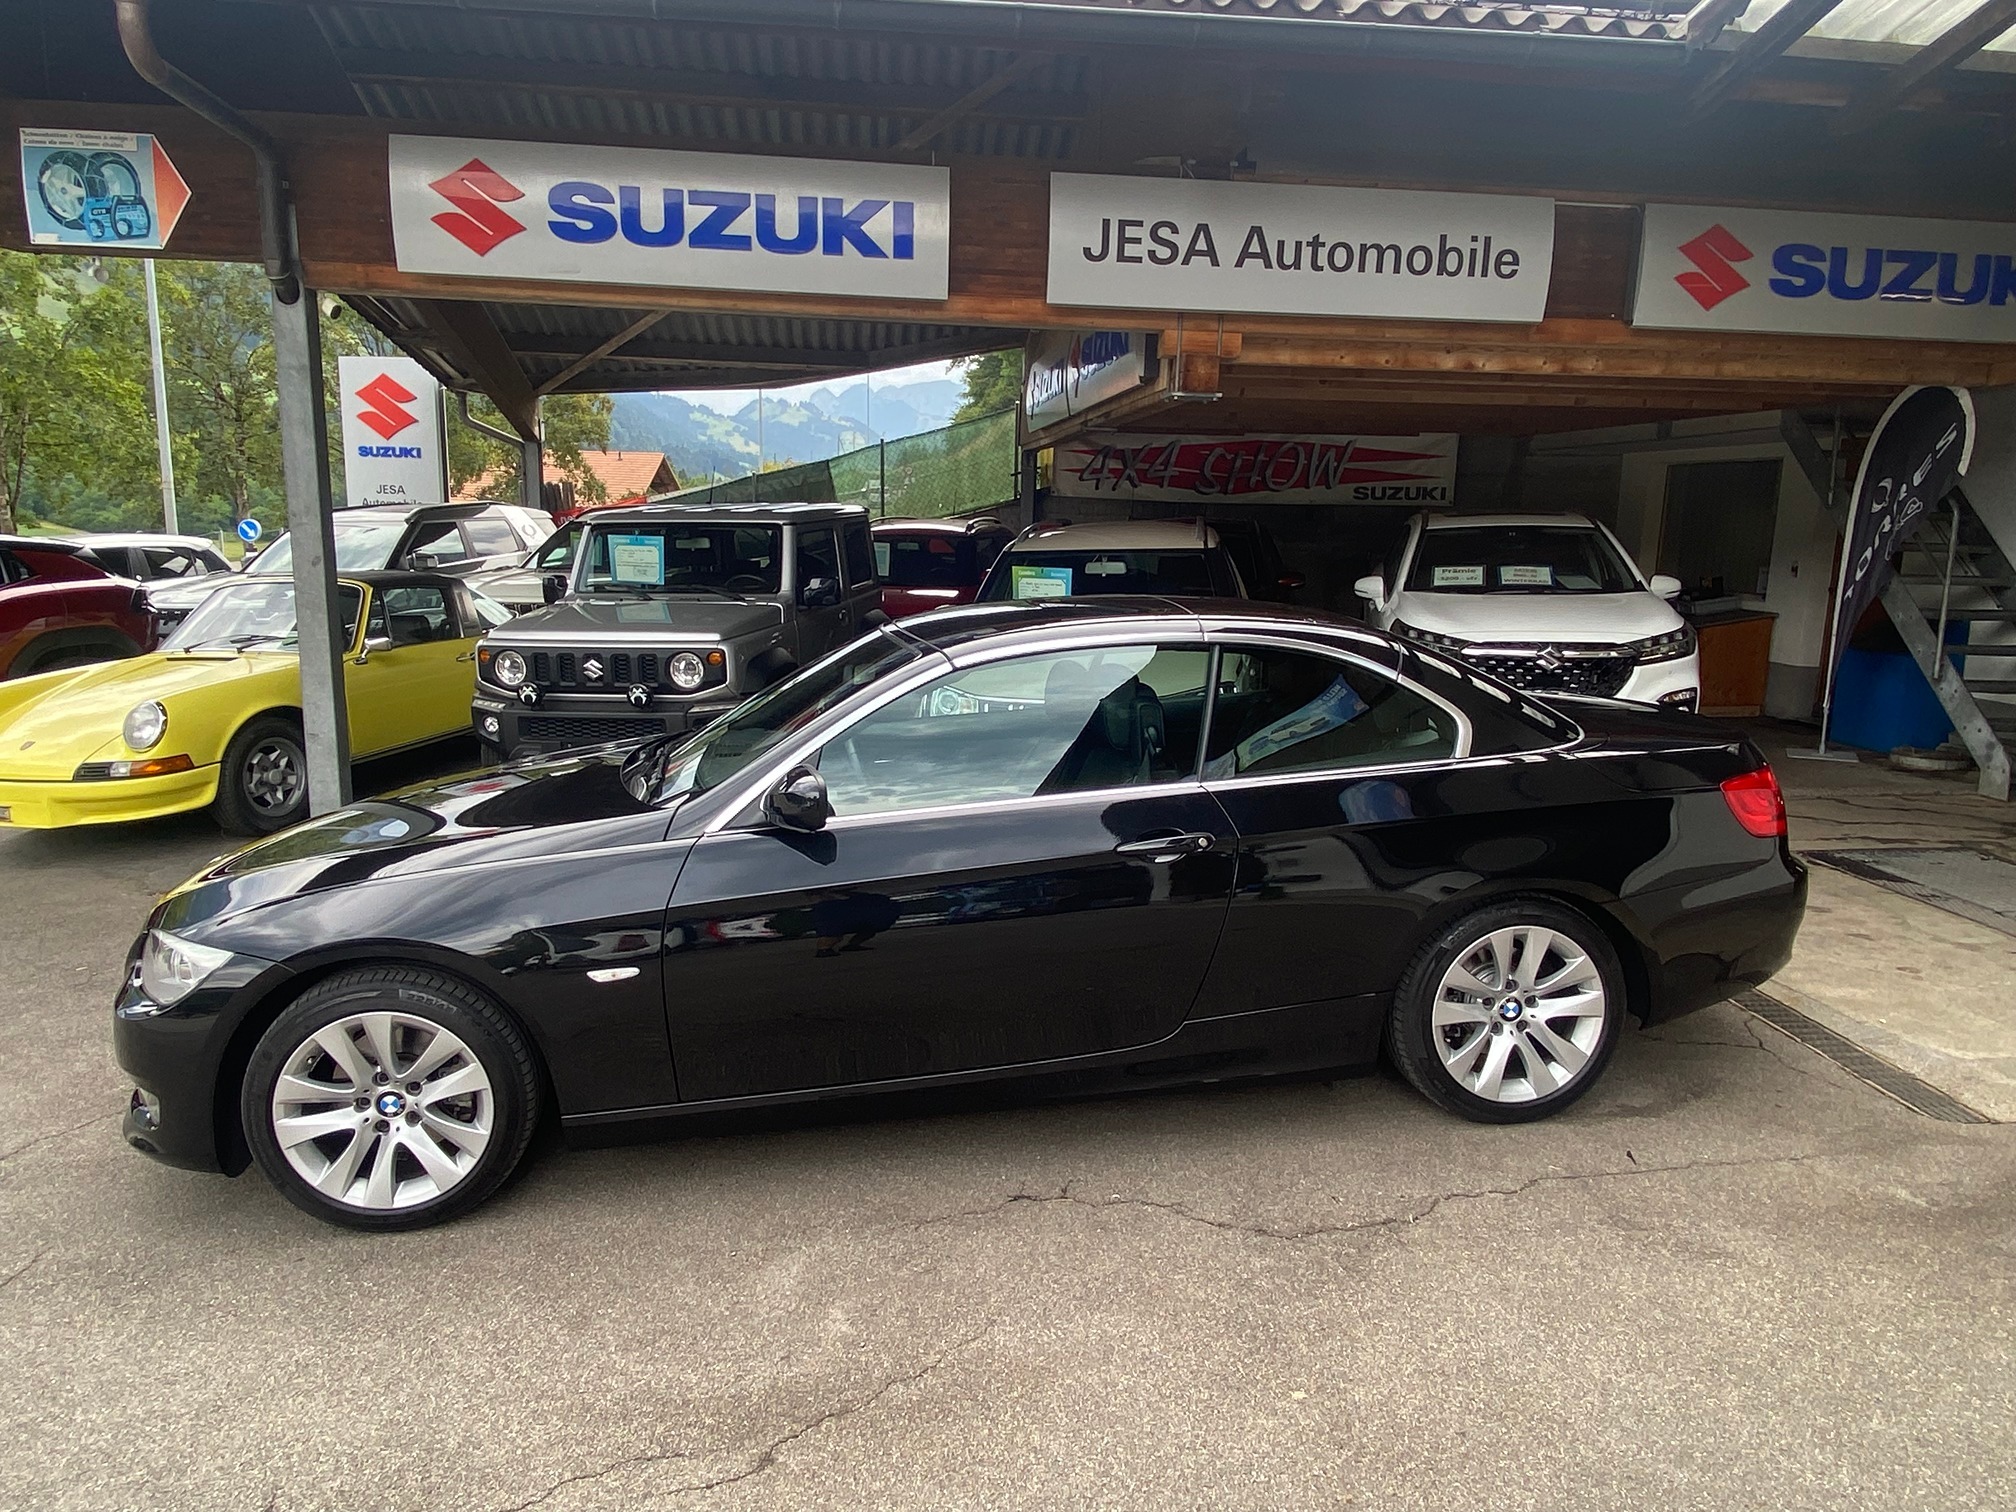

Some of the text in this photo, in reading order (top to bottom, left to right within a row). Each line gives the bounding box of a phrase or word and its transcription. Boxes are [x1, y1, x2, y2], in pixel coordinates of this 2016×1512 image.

[547, 181, 914, 260] SUZUKI
[1082, 218, 1521, 279] JESA Automobile
[358, 446, 422, 459] SUZUKI
[1195, 440, 1357, 496] SHOW
[376, 484, 406, 495] JESA
[1353, 485, 1447, 501] SUZUKI
[362, 497, 422, 506] Autombil
